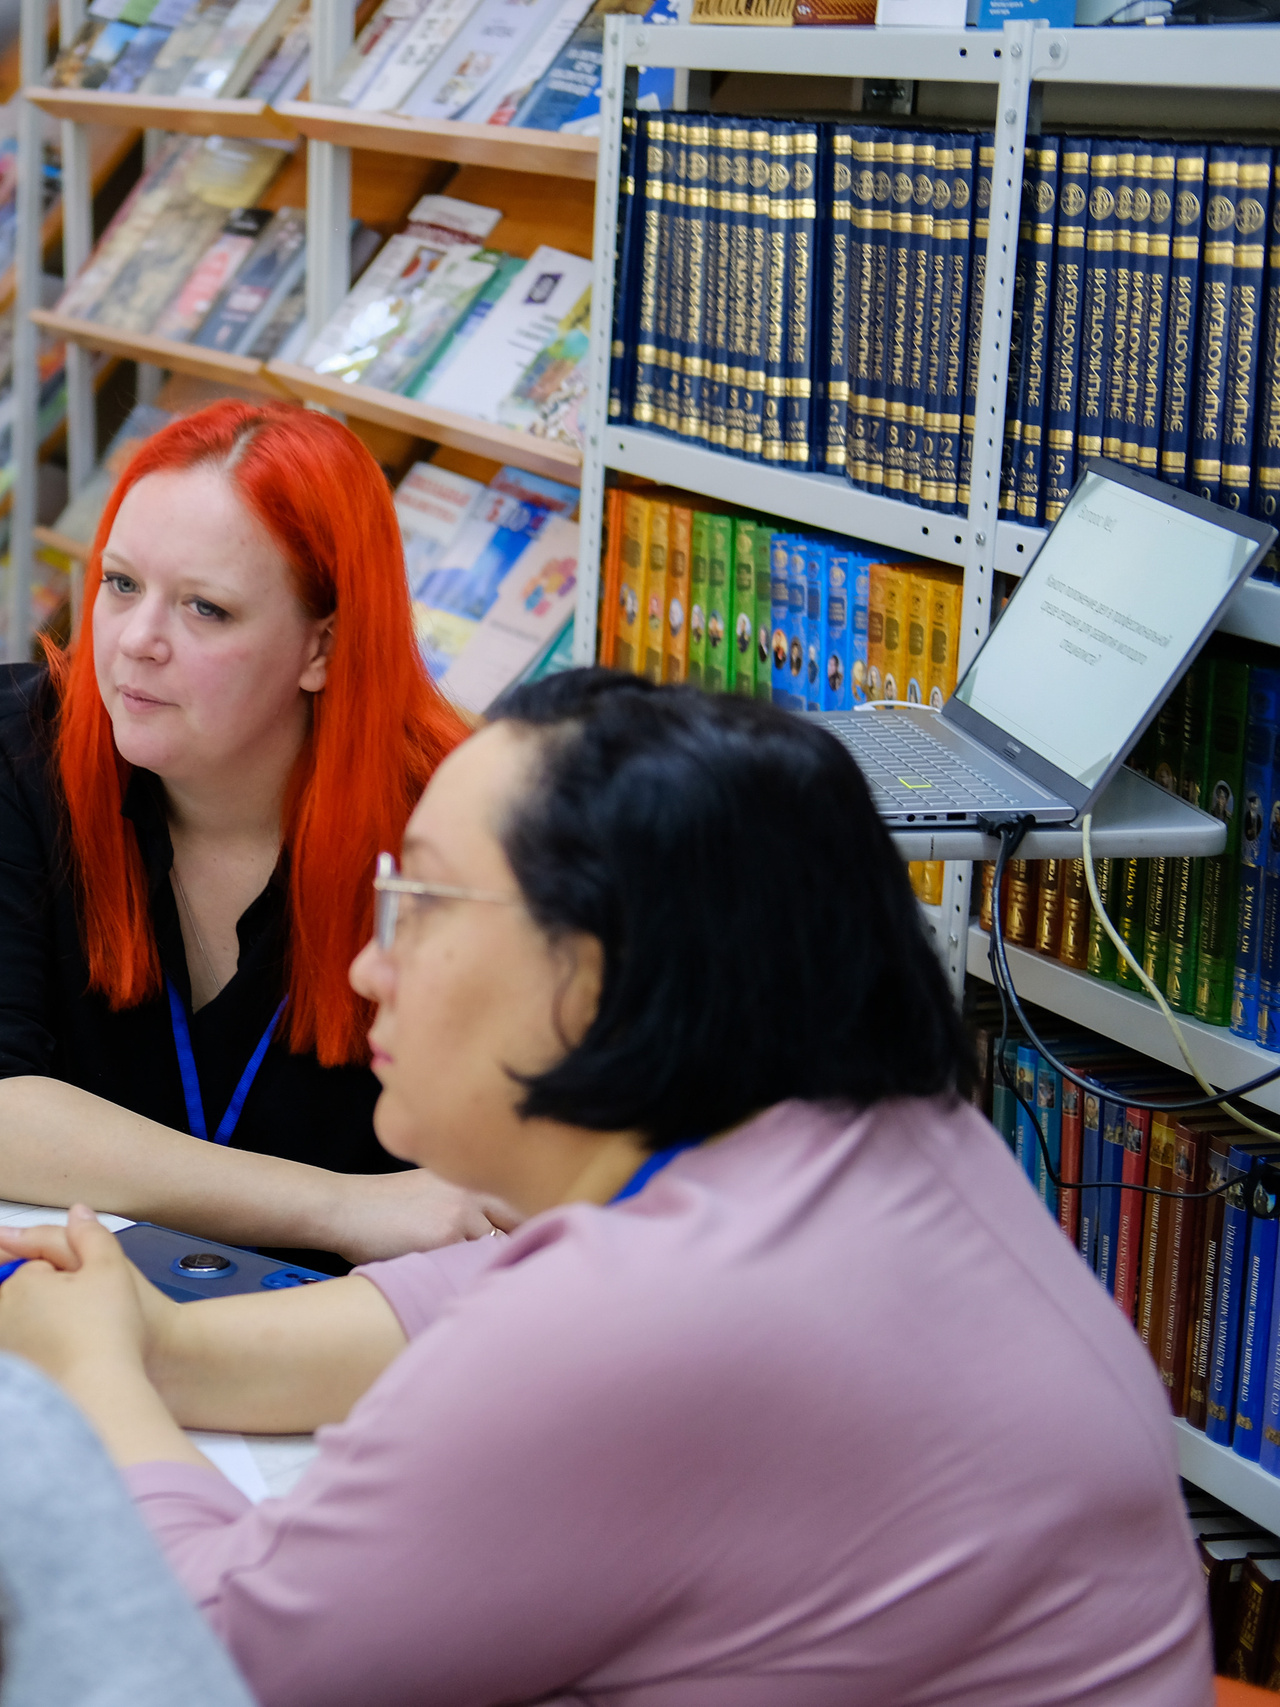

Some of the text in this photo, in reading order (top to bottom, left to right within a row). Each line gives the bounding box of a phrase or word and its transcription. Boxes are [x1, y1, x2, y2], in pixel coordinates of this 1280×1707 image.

[831, 233, 847, 366] ЭНЦИКЛОПЕДИЯ
[858, 243, 872, 379] ЭНЦИКЛОПЕДИЯ
[892, 247, 908, 386] ЭНЦИКЛОПЕДИЯ
[911, 250, 927, 389] ЭНЦИКЛОПЕДИЯ
[928, 254, 945, 396] ЭНЦИКЛОПЕДИЯ
[947, 254, 964, 397] ЭНЦИКЛОПЕДИЯ
[1028, 260, 1048, 407] ЭНЦИКЛОПЕДИЯ
[1058, 263, 1079, 412] ЭНЦИКЛОПЕДИЯ
[1086, 268, 1107, 418] ЭНЦИКЛОПЕДИЯ
[1110, 268, 1129, 419] ЭНЦИКЛОПЕДИЯ
[1124, 271, 1144, 424] ЭНЦИКЛОПЕДИЯ
[1143, 273, 1164, 428] ЭНЦИКЛОПЕДИЯ
[1170, 276, 1192, 432] ЭНЦИКЛОПЕДИЯ
[1203, 281, 1227, 440] ЭНЦИКЛОПЕДИЯ
[1231, 285, 1256, 446] ЭНЦИКЛОПЕДИЯ
[1127, 866, 1137, 892] ТРИ
[1177, 923, 1185, 939] НА
[1178, 893, 1188, 923] БЕРЕГ
[1240, 934, 1251, 954] ВО
[1143, 1291, 1154, 1328] ВЕЛИКИХ
[1145, 1232, 1160, 1291] ПОЛКОВОДЦЕВ
[1166, 1303, 1177, 1341] ВЕЛИКИХ
[1169, 1258, 1181, 1303] ПРОРОКОВ
[1197, 1239, 1218, 1379] ПОЛКОВОДЦЕВ ЗАПАДНОЙ ЕВРОПЫ
[1214, 1223, 1238, 1392] СТО ВЕЛИКИХ МИФОВ И ЛЕГЕНД
[1240, 1254, 1262, 1402] СТО ВЕЛИКИХ РУССКИХ ЭМИГРАНТОВ
[1141, 1328, 1150, 1345] СТО
[1165, 1341, 1173, 1360] СТО
